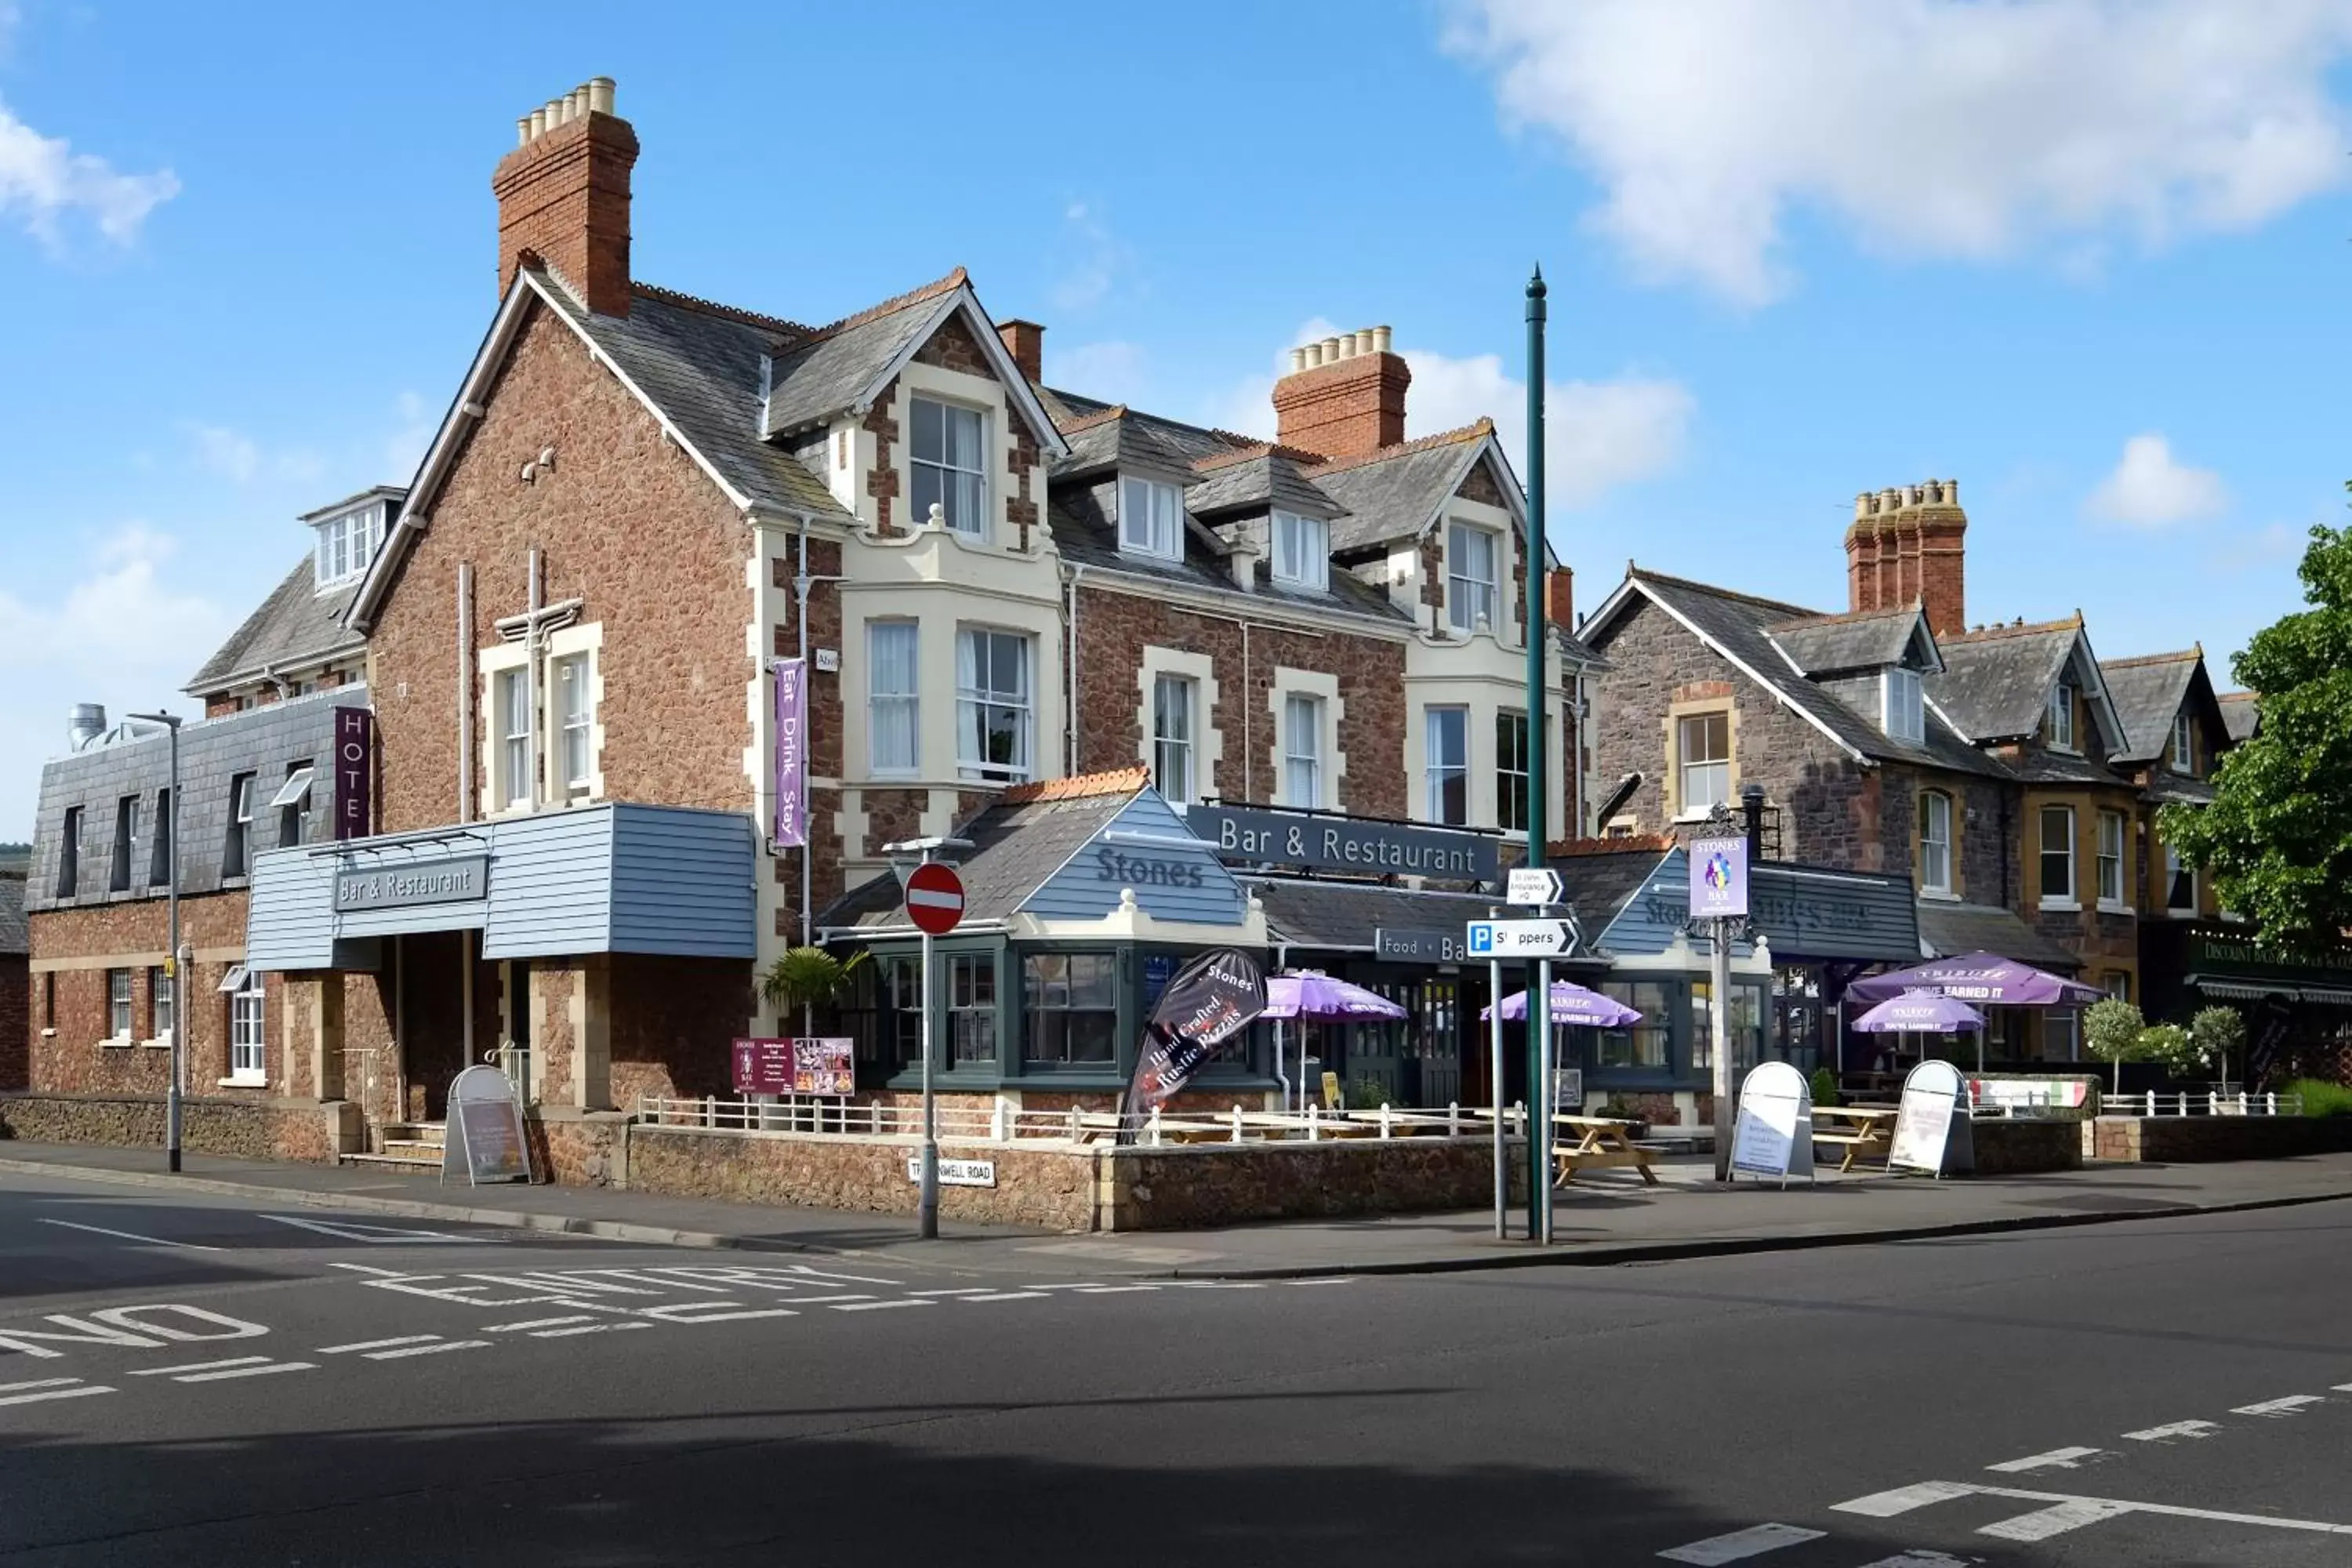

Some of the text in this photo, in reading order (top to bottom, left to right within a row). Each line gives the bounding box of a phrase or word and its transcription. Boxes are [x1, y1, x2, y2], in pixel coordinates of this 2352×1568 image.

[782, 670, 797, 835] Eat Drink Stay
[1221, 818, 1475, 874] Bar & Restaurant
[1695, 840, 1740, 853] STONES
[340, 867, 470, 902] Bar & Restaurant
[1098, 848, 1203, 887] Stones
[1646, 898, 1689, 924] Ston
[1385, 937, 1469, 961] Food Ba
[1497, 932, 1553, 945] Sppers
[1208, 965, 1254, 992] Stones
[1944, 985, 1989, 998] EARNED
[1992, 987, 2003, 998] IT
[1149, 994, 1221, 1067] Hand Crafted
[1156, 1008, 1241, 1089] Rustic Pizzas
[967, 1166, 990, 1180] ROAD
[358, 1265, 905, 1307] ENTRY
[0, 1304, 271, 1359] NO
